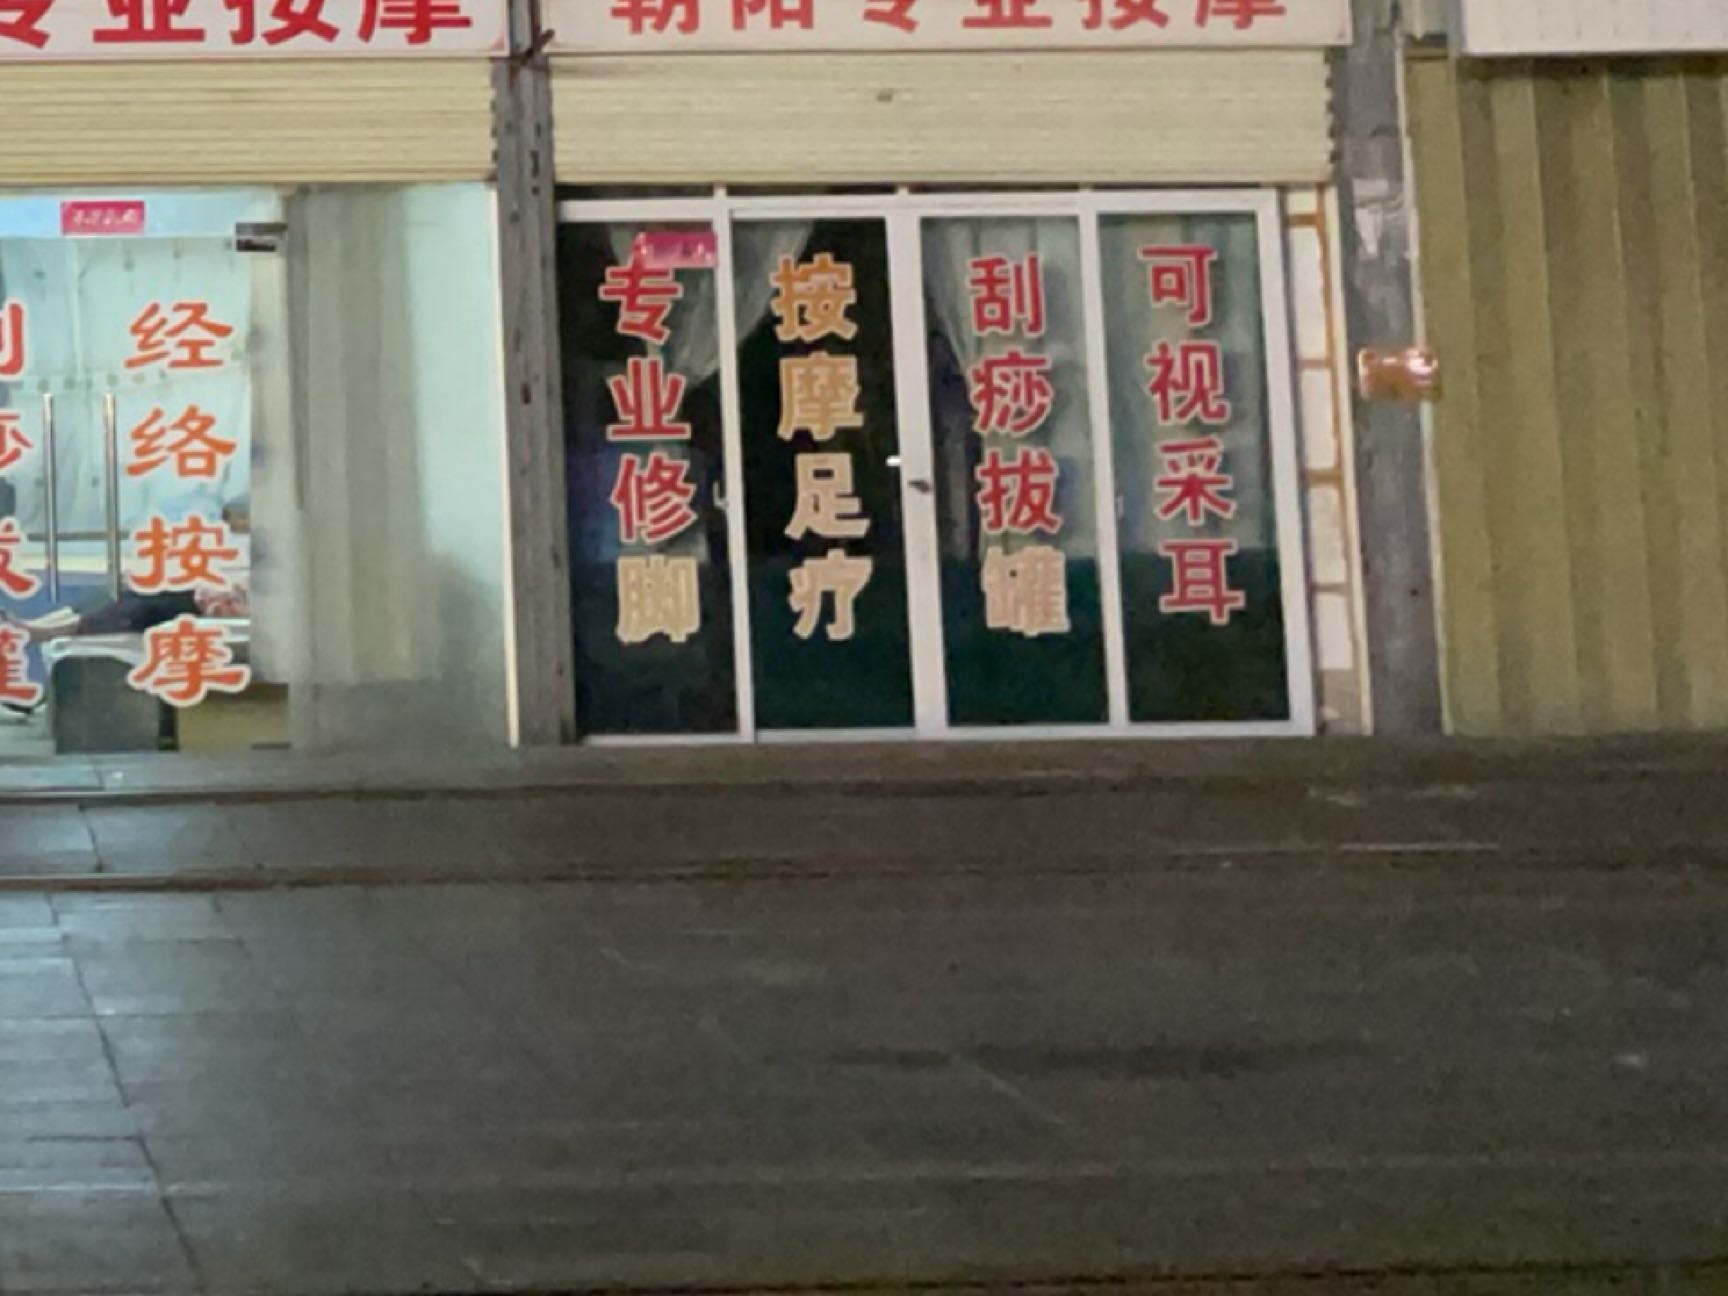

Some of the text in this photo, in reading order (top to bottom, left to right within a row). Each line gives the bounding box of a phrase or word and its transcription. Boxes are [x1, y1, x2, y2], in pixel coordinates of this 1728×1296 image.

[123, 300, 251, 704] 经络按摩
[772, 251, 873, 642] 按摩足疗
[1138, 243, 1245, 626] 可视采耳
